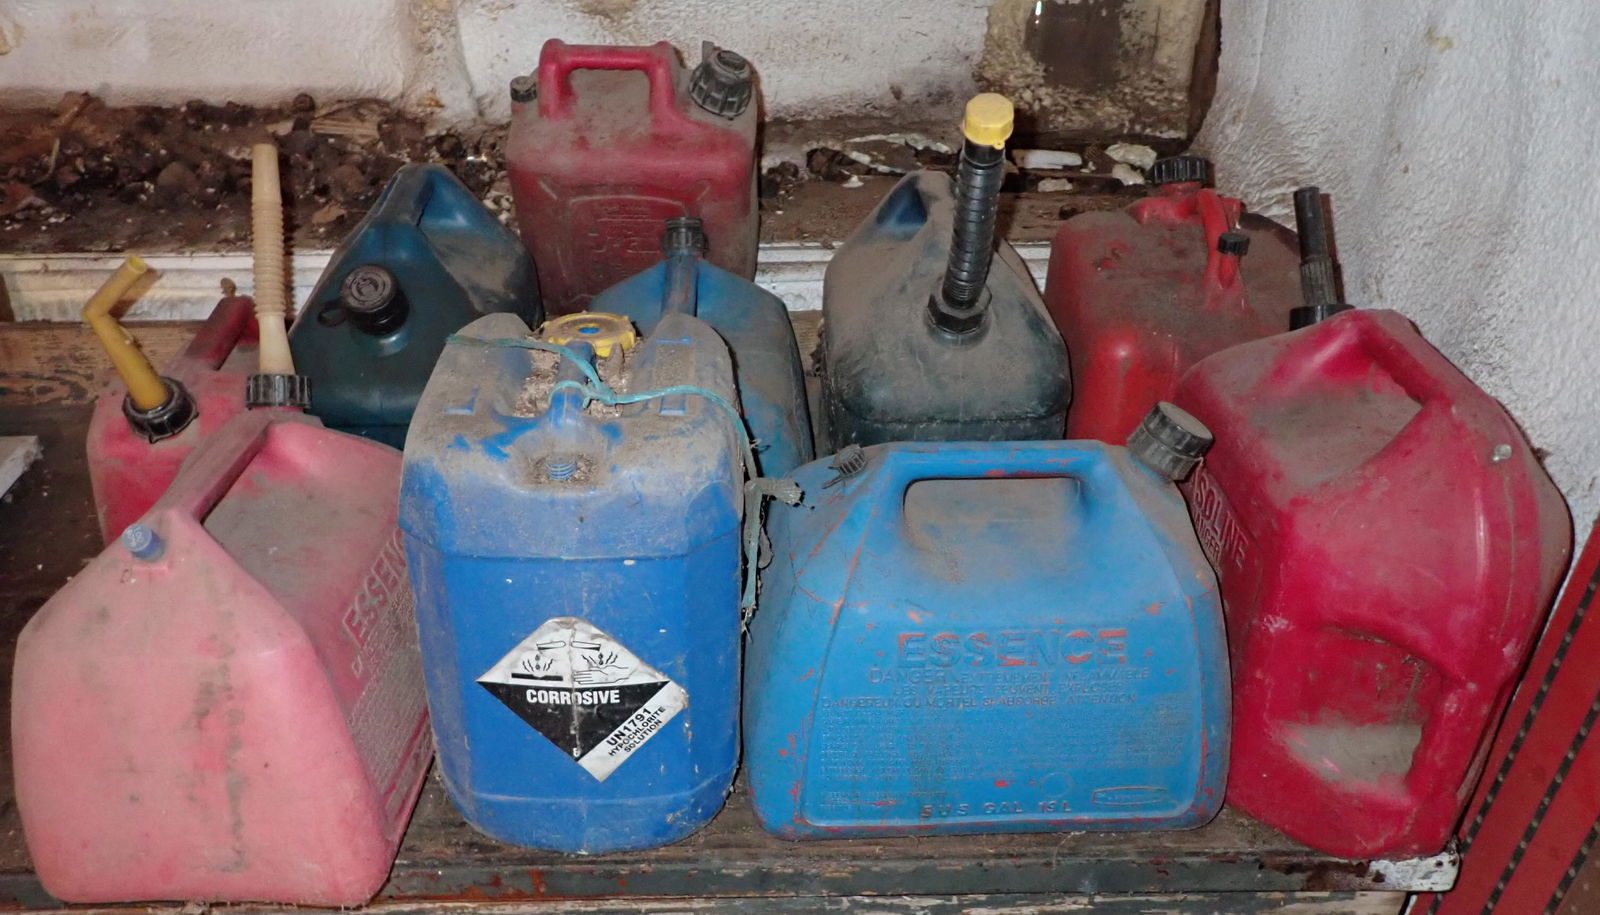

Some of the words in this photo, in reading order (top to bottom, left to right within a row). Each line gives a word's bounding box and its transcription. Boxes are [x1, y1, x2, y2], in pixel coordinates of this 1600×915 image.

[898, 629, 1128, 668] ESSENCE
[526, 689, 620, 706] CORROSIVE
[606, 708, 651, 746] UN1791
[608, 706, 666, 757] HYPOCHLORITE
[624, 719, 662, 752] SOLUTION
